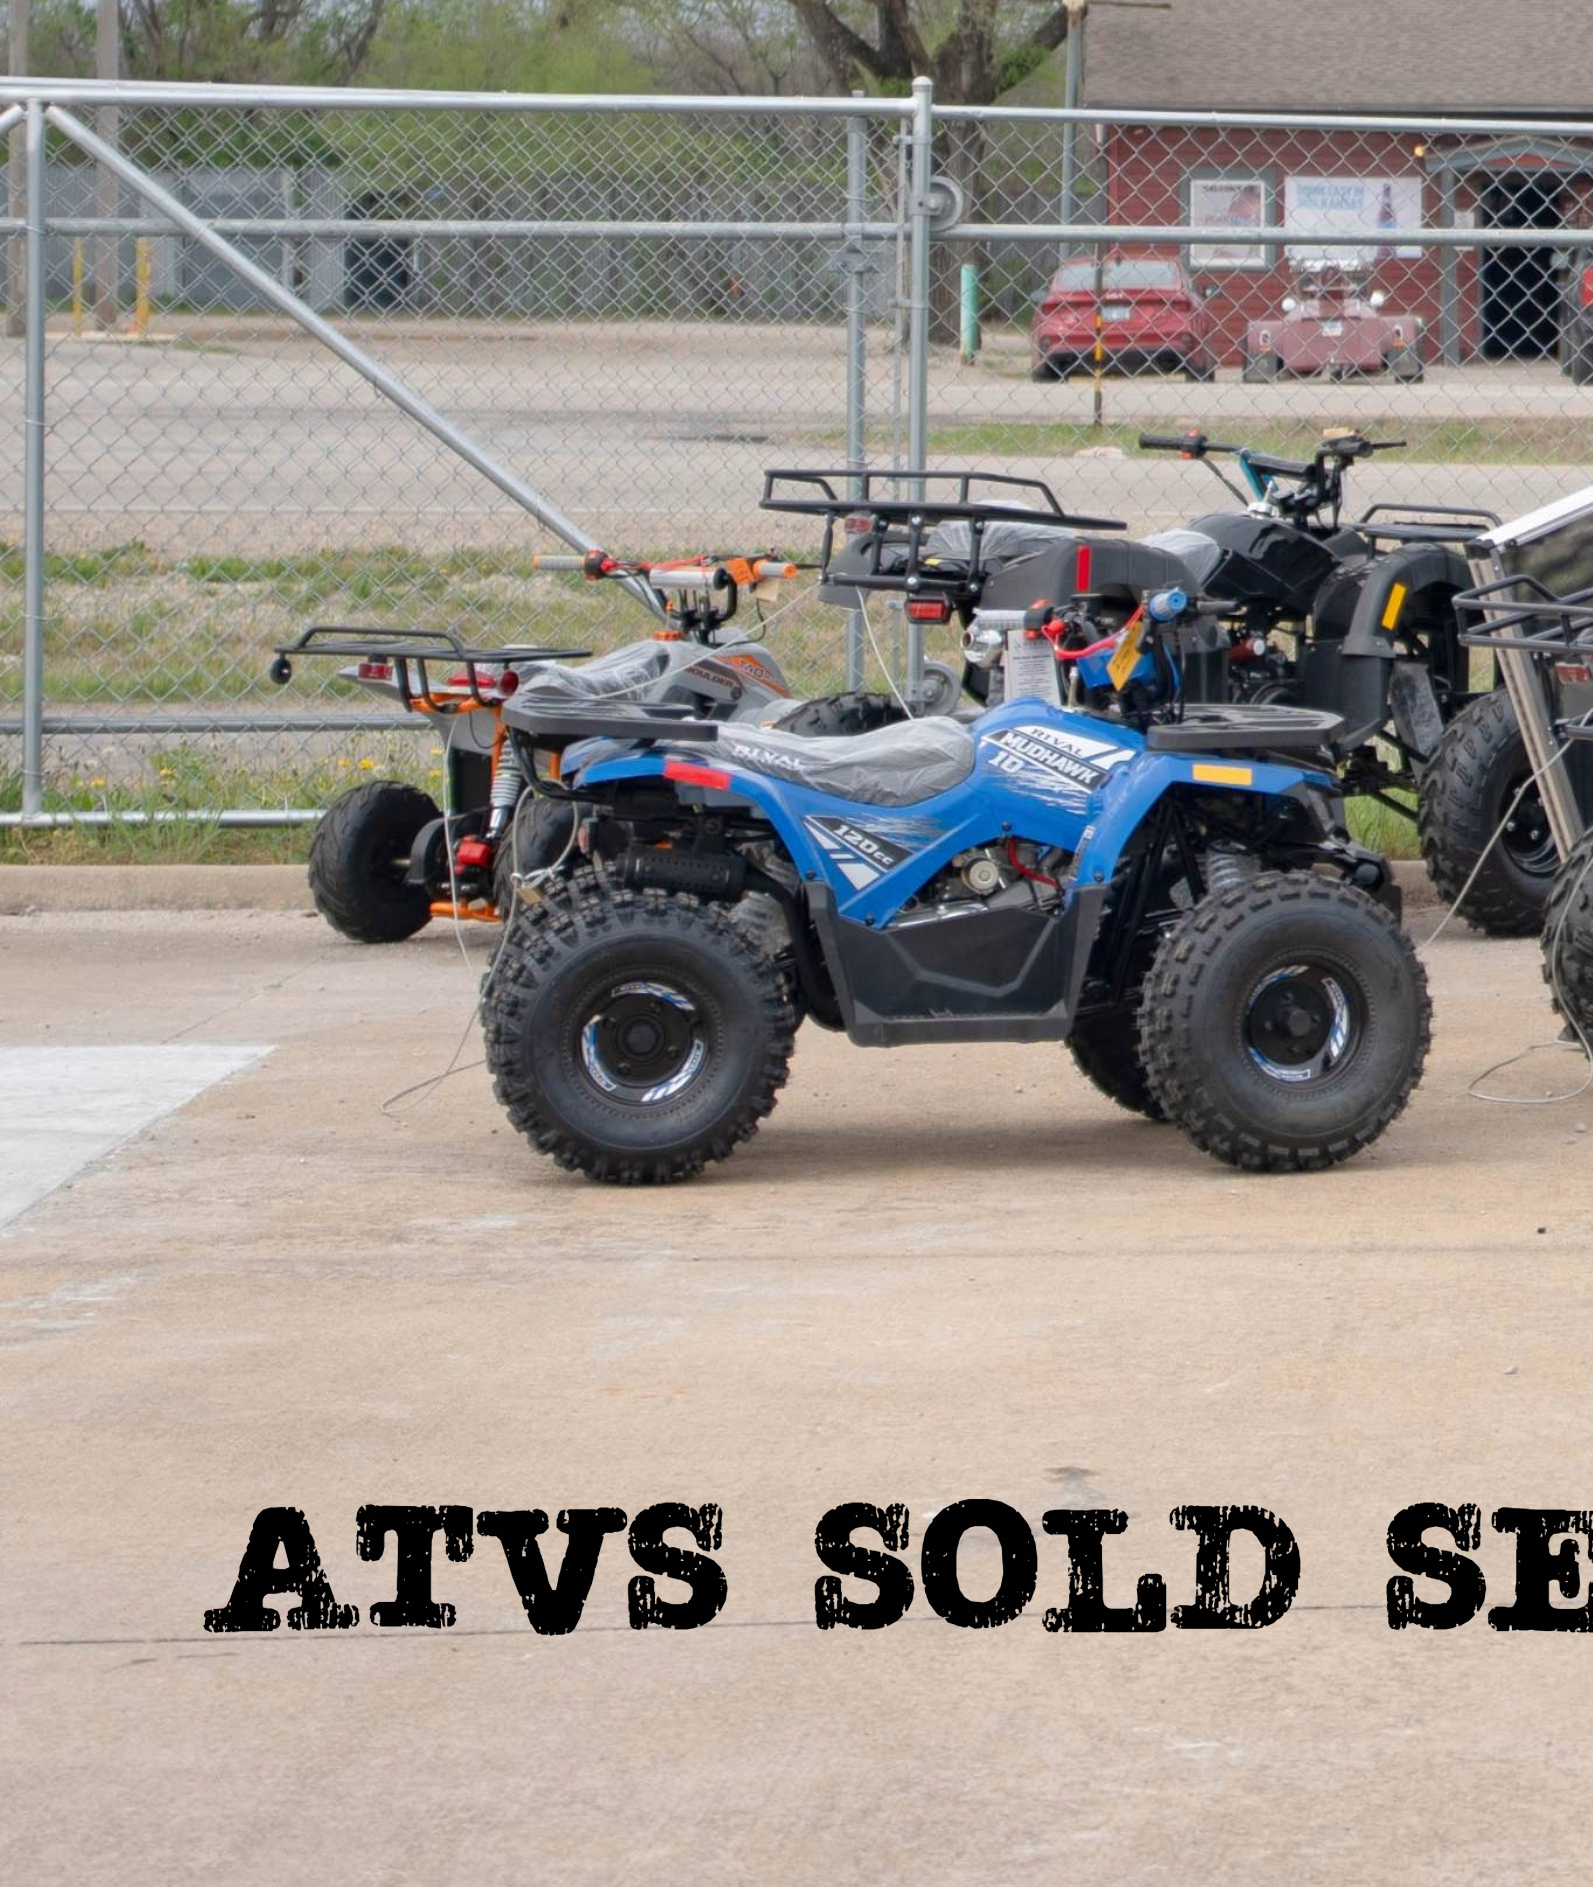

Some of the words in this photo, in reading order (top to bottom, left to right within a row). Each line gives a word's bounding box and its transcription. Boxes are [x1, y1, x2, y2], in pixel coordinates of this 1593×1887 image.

[999, 731, 1100, 785] MUDHAWK
[1030, 727, 1084, 758] RIVAL
[987, 750, 1026, 774] 10
